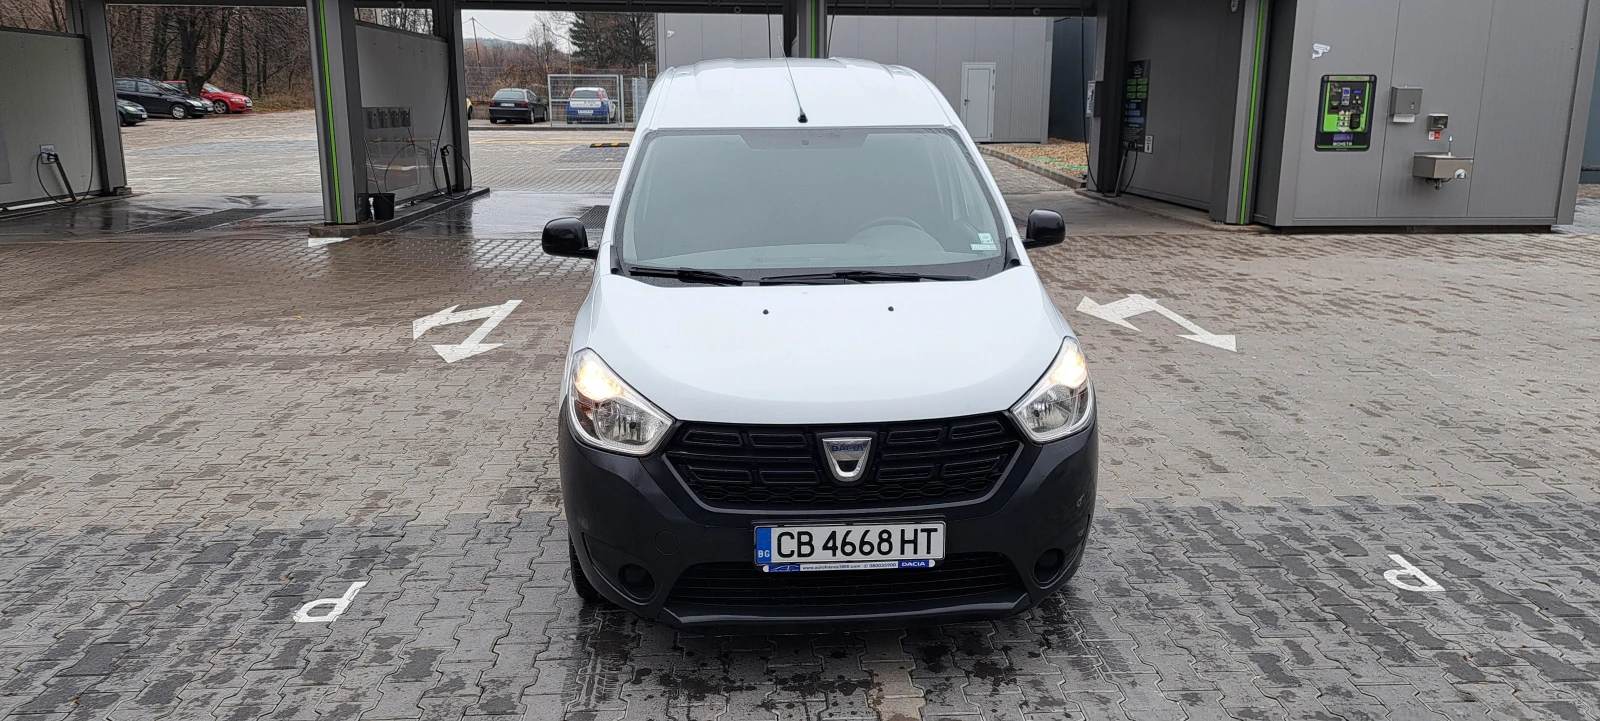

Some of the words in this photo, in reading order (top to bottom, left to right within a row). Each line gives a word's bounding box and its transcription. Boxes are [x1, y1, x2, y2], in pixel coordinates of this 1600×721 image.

[776, 530, 815, 559] CB
[821, 529, 893, 557] 4668
[900, 527, 938, 556] HT
[757, 550, 771, 559] BG
